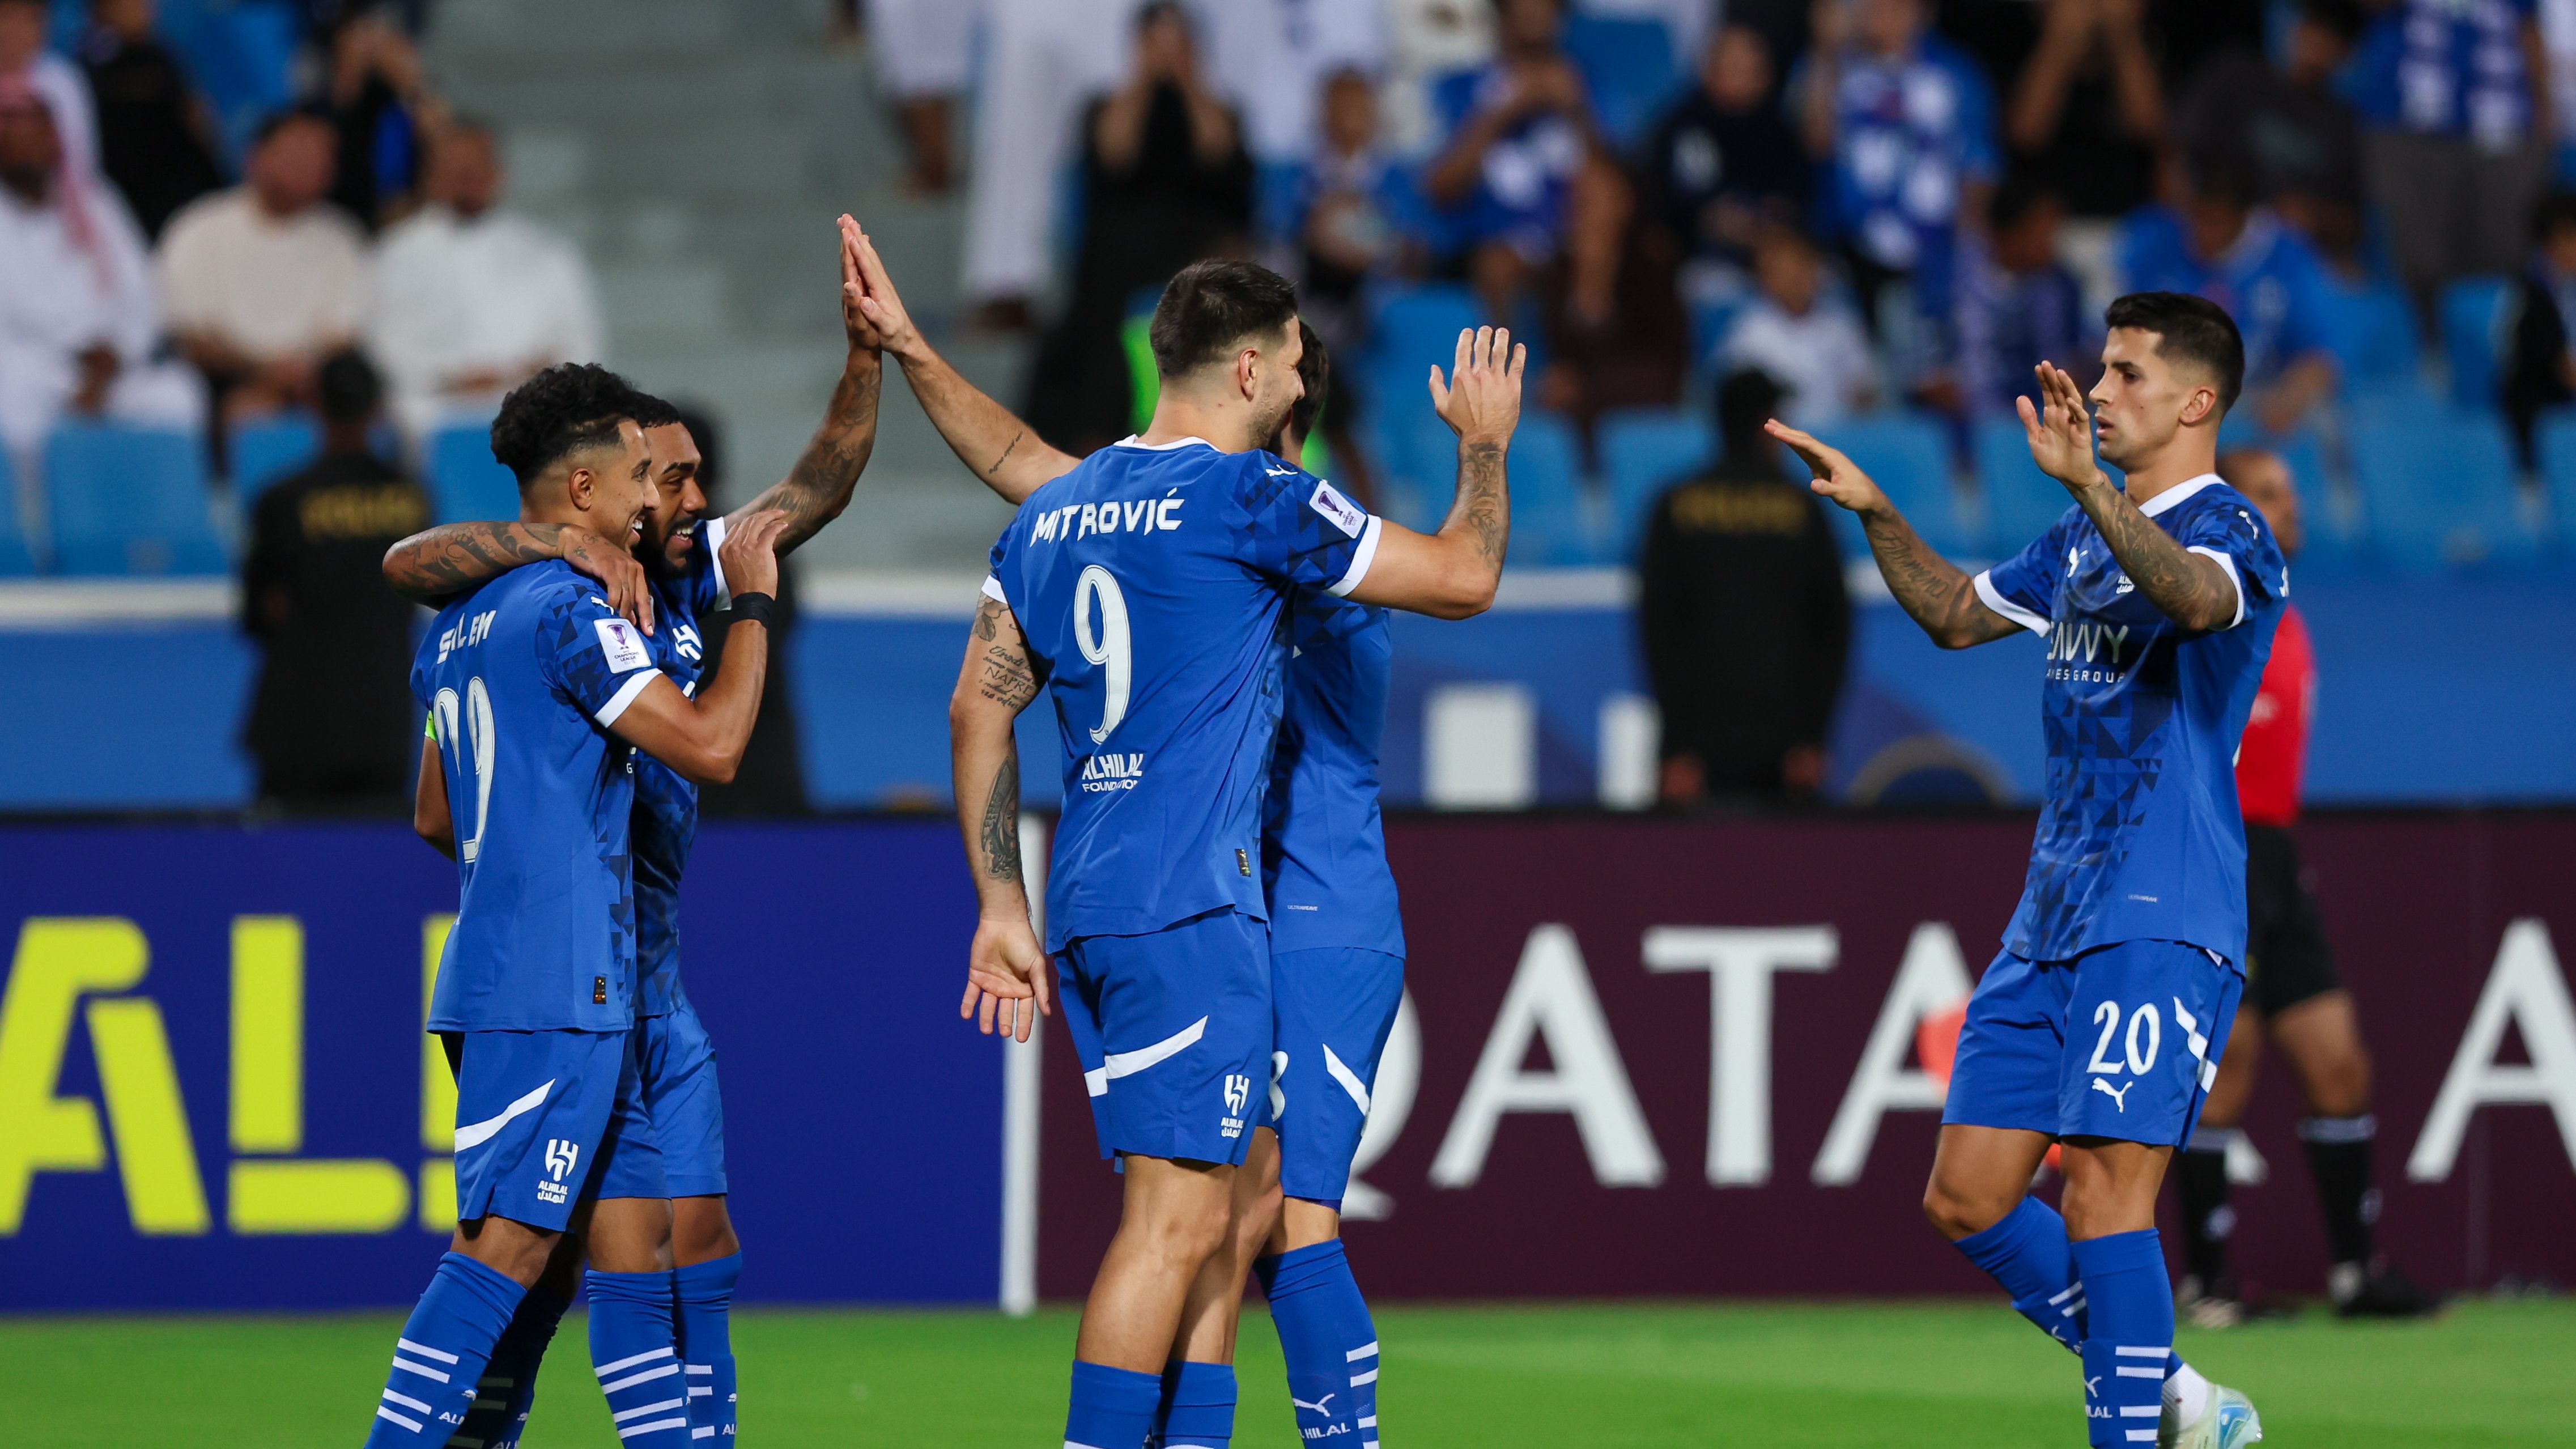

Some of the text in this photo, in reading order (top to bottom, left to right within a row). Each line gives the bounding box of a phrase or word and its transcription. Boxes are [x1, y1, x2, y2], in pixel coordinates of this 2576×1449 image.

[1029, 487, 1185, 548] MITROVIĆ
[1074, 564, 1132, 745] 9
[2086, 1000, 2161, 1076] 20
